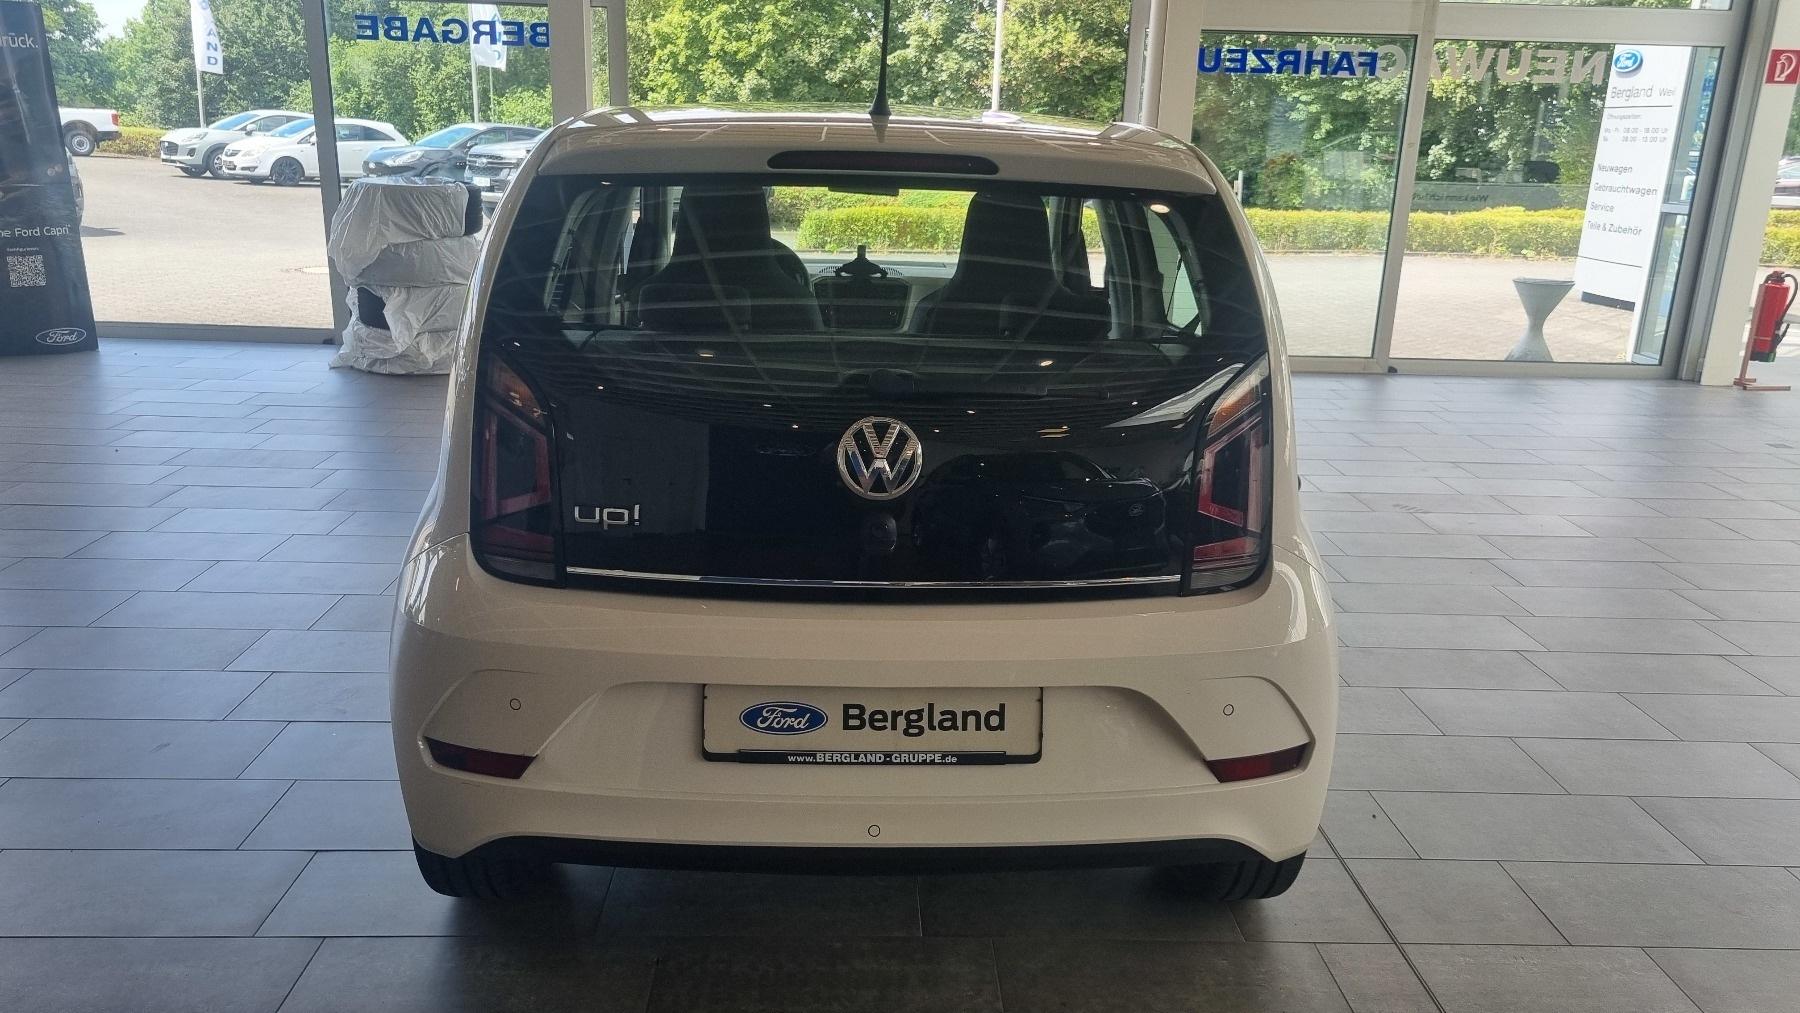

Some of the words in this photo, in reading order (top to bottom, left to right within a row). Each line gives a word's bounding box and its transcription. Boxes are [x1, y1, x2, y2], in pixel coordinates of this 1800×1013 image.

[0, 33, 40, 48] rück.
[1610, 84, 1654, 102] Bergland
[1597, 163, 1633, 175] Neuwagen
[1593, 182, 1658, 197] Gebrauchtwagen
[1590, 201, 1615, 213] Service
[15, 226, 40, 237] Ford
[1587, 220, 1601, 231] Teile
[1608, 223, 1642, 236] Zubehör
[46, 329, 78, 343] Ford
[574, 504, 640, 530] up!
[755, 705, 811, 730] Ford
[842, 702, 1006, 737] Bergland
